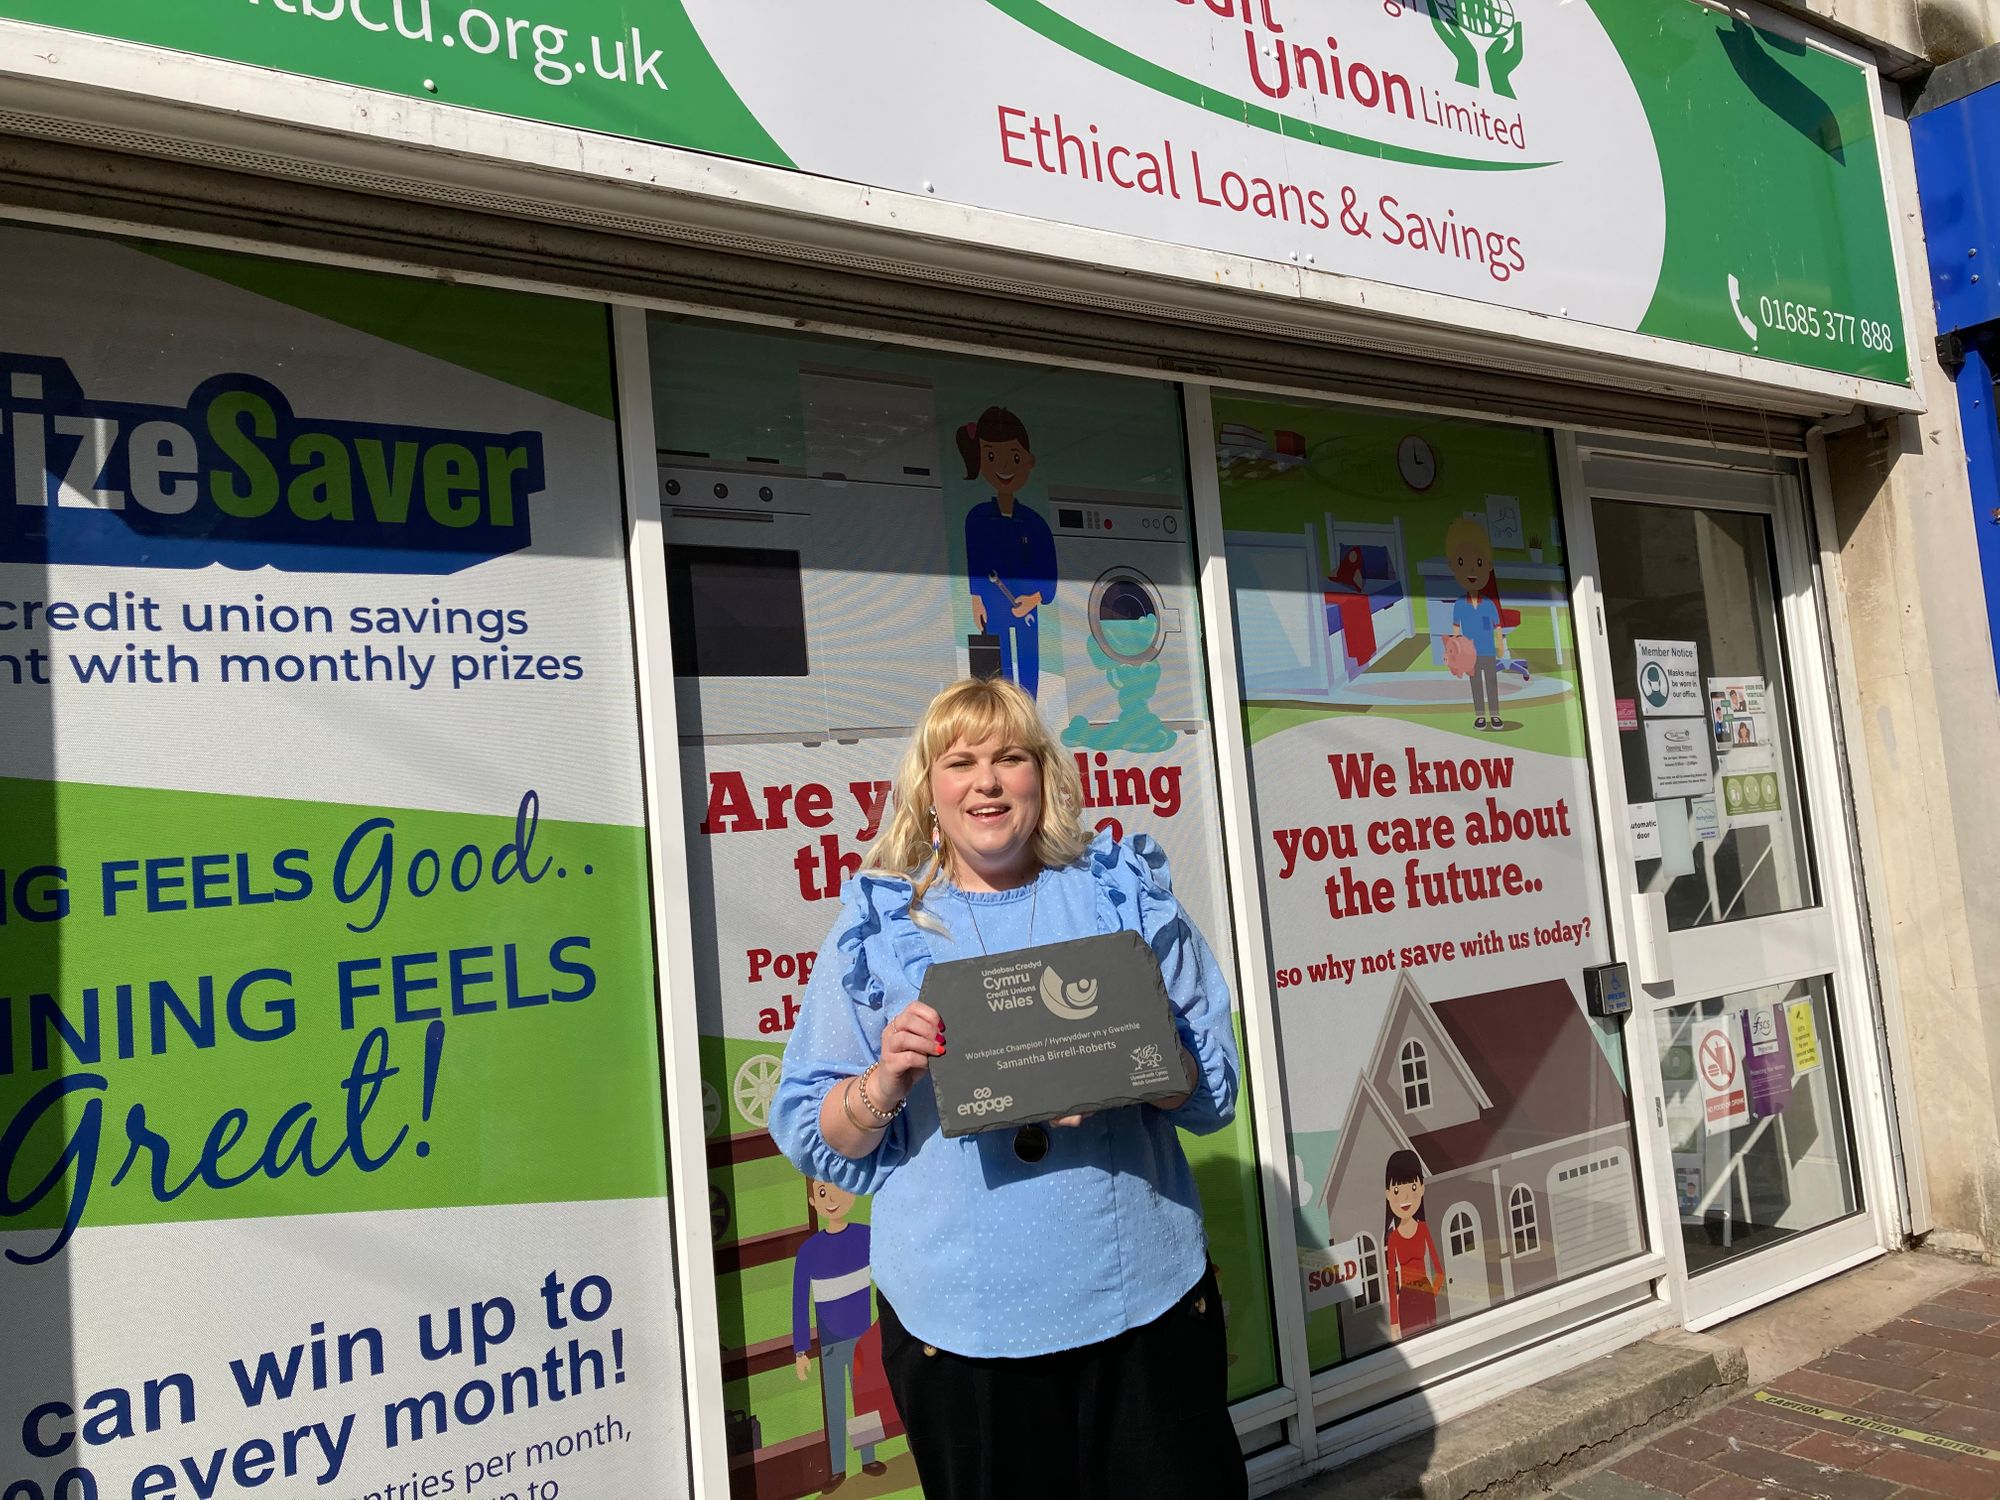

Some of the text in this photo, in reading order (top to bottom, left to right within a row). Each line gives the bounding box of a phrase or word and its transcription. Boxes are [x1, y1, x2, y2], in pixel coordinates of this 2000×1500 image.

[1245, 29, 1526, 150] Union Limited
[997, 105, 1526, 282] Ethical Loans & Savings
[1760, 296, 1893, 353] 01685 377 888
[0, 372, 529, 528] izeSaver
[183, 594, 333, 632] union
[350, 597, 529, 643] savings
[69, 643, 199, 684] with
[221, 645, 436, 690] monthly
[452, 645, 584, 689] prizes
[1641, 646, 1694, 658] Member Notice
[1667, 669, 1684, 677] Masks
[700, 771, 835, 835] Are
[1073, 752, 1183, 818] ling
[1327, 747, 1514, 800] We know
[1272, 796, 1572, 880] you care about
[0, 865, 70, 925] G
[102, 848, 313, 917] FEELS
[1325, 858, 1543, 920] the future..
[981, 960, 1042, 977] Undebau Credyd
[1276, 916, 1592, 989] so why not save with us today?
[0, 936, 597, 1077] NING FEELS
[983, 972, 1031, 991] Cymru
[986, 985, 1036, 1000] Credit Unions
[987, 995, 1034, 1012] Wales
[965, 1047, 1005, 1061] Workplace
[1005, 1039, 1043, 1053] Champion
[1049, 1030, 1091, 1045] Hyrwyddwr
[1092, 1029, 1101, 1038] yn
[1108, 1021, 1141, 1034] Gweithle
[996, 1039, 1117, 1070] Samantha Birrell-Roberts
[957, 1094, 1014, 1116] engage
[1308, 1260, 1357, 1293] SOLD
[21, 1269, 613, 1458] can win up to
[131, 1327, 627, 1500] every month!
[1765, 1396, 1989, 1455] CAUTION CAUTION CAUTION
[465, 1449, 517, 1493] per
[526, 1414, 632, 1468] month,
